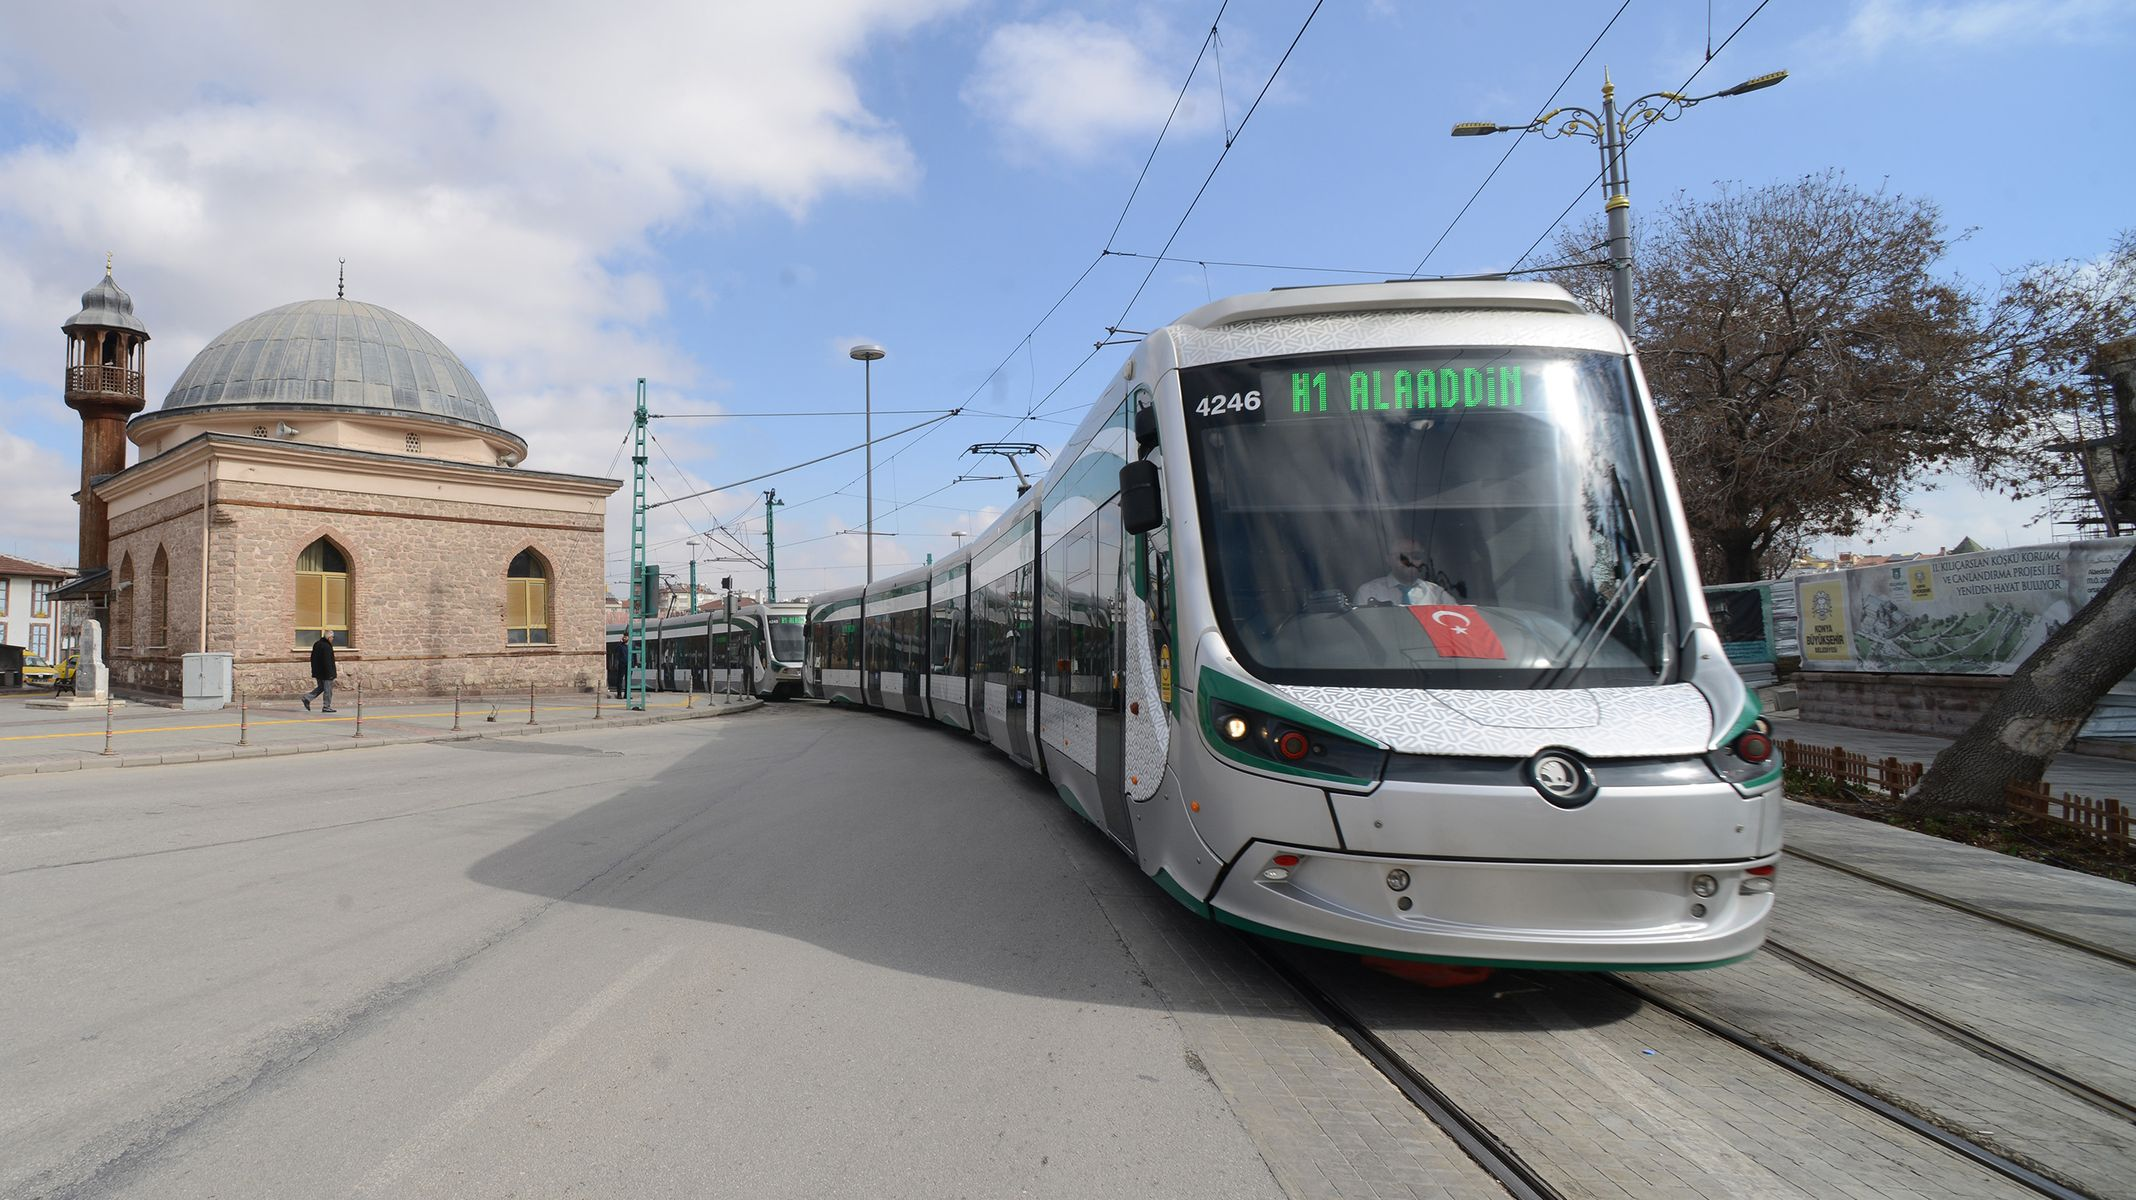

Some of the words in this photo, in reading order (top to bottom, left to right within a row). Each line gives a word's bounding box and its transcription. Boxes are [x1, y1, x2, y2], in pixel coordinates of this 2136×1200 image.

[1292, 372, 1327, 412] H1
[1195, 391, 1261, 416] 4246
[1941, 558, 1989, 572] KILIÇARSLAN
[2021, 551, 2060, 563] KORUMA
[1943, 575, 1952, 584] VE
[1952, 570, 2011, 583] CANLANDIRMA
[1956, 584, 1992, 596] YENİDEN
[1994, 581, 2019, 593] HAYAT
[2021, 579, 2061, 591] BULUYOR
[1814, 624, 1833, 633] KONYA
